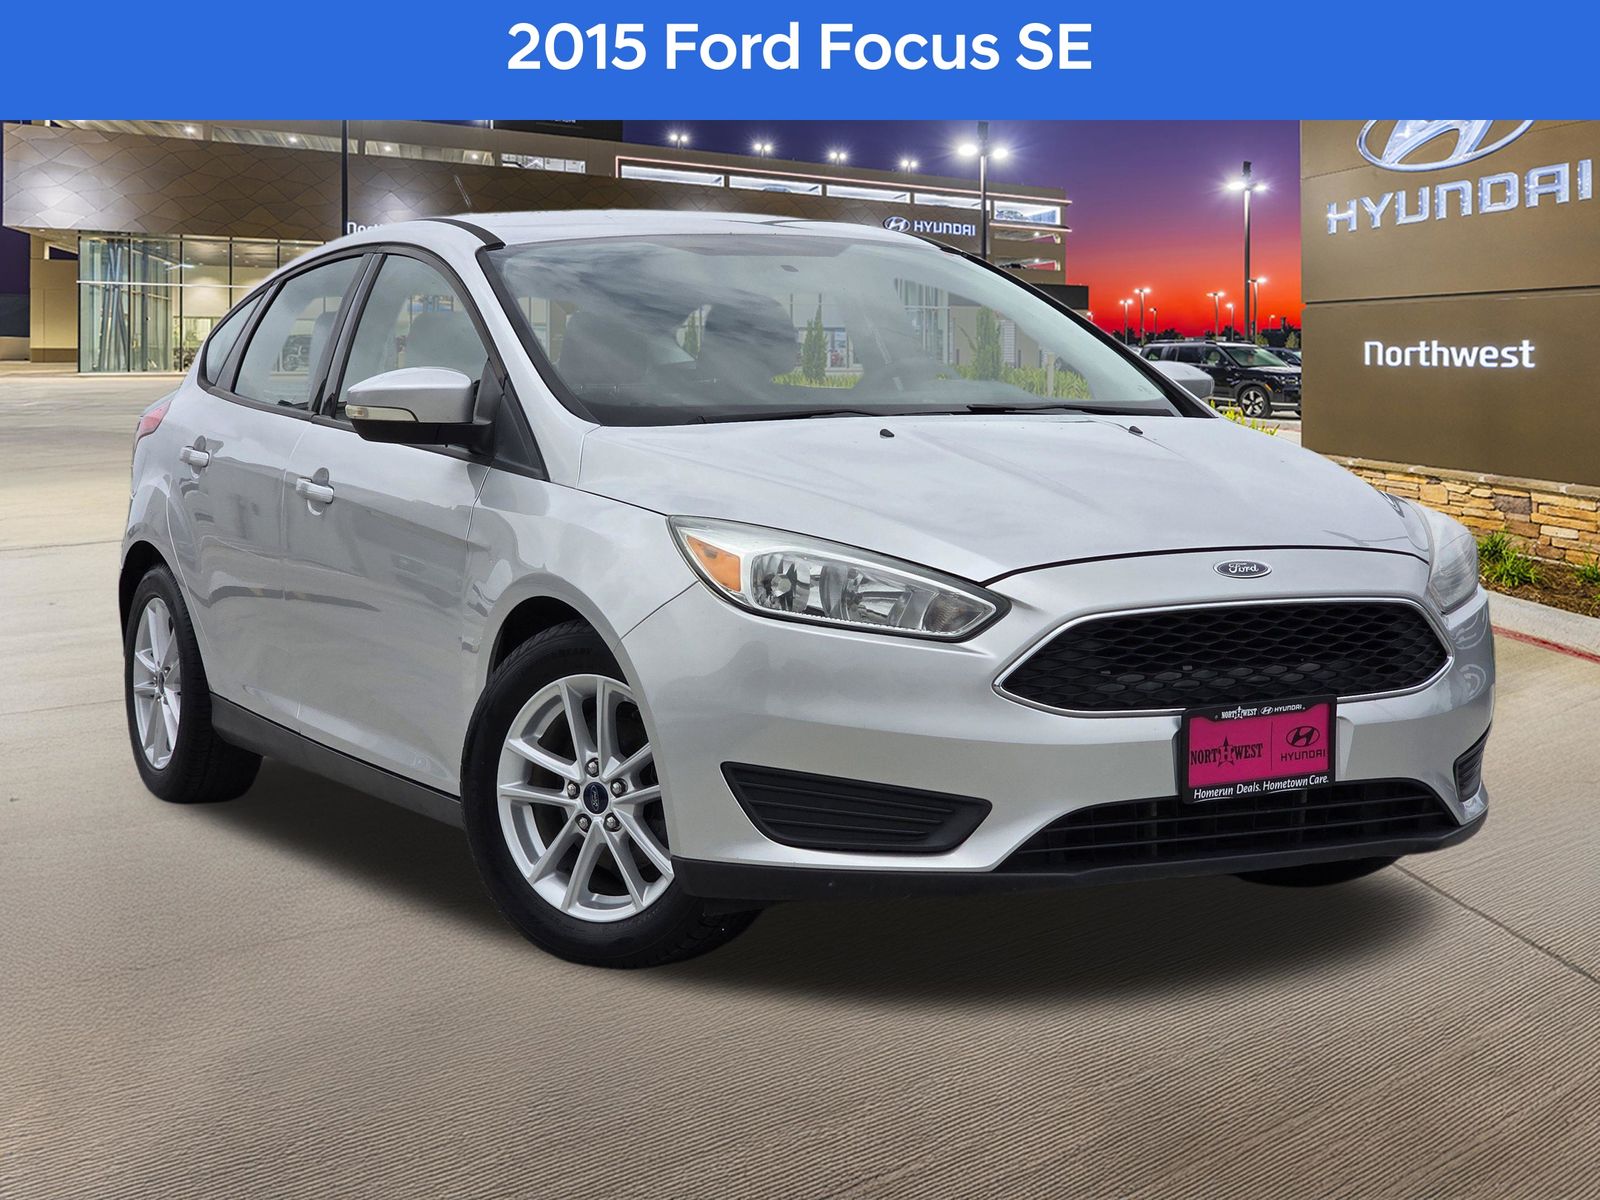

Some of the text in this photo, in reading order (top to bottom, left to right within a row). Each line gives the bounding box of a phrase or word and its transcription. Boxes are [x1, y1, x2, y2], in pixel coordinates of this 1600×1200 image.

[1327, 159, 1592, 235] HYUNDAI
[913, 220, 976, 236] HYUNDAI
[1364, 340, 1535, 368] Northwest
[1228, 562, 1259, 573] Ford
[1274, 704, 1302, 712] HYUNDAI
[1281, 750, 1326, 762] HYUNDAI
[1194, 775, 1329, 799] Homerun Deals. Hometown Care.
